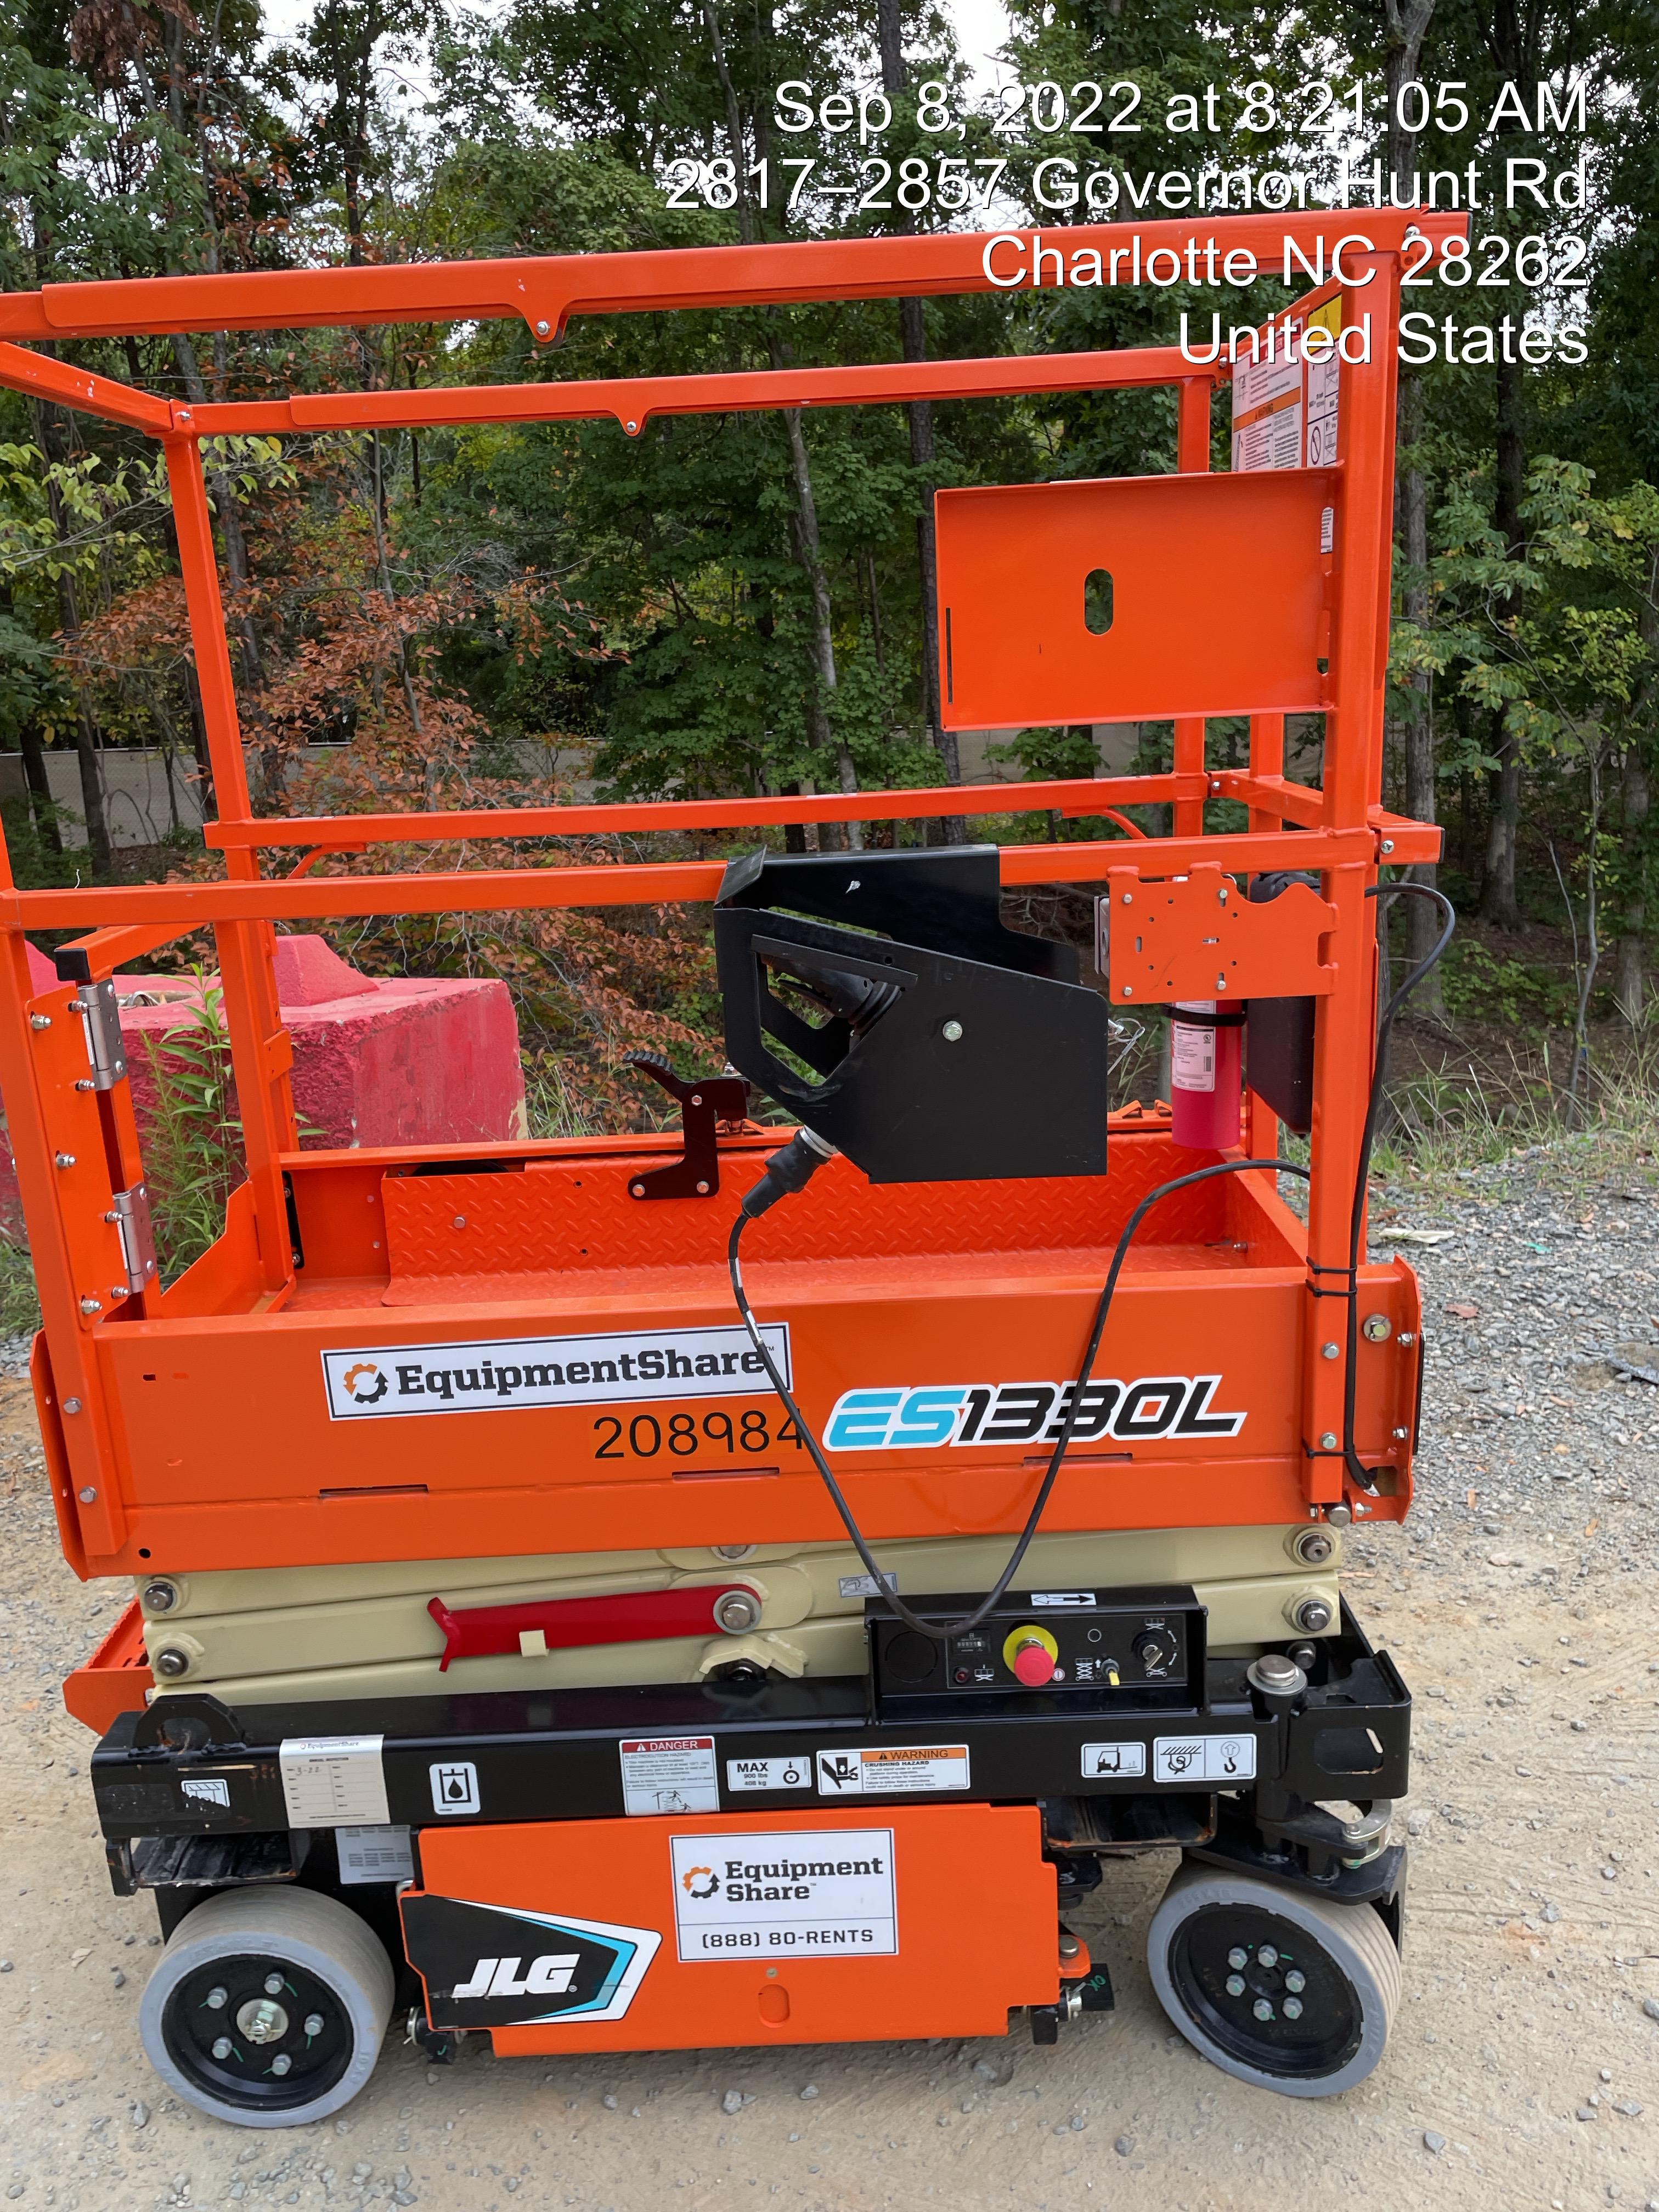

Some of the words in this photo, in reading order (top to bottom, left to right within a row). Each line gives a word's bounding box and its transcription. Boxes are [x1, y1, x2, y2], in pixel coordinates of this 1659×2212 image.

[395, 1348, 766, 1400] EquipmentShare
[827, 1378, 1243, 1448] ES1330L
[593, 1408, 803, 1460] 208984
[650, 1740, 698, 1751] DANGER
[890, 1749, 949, 1760] WARNING
[737, 1762, 769, 1773] MAX
[725, 1858, 883, 1882] Equipment
[726, 1883, 810, 1902] Share
[702, 1932, 760, 1949] (888)
[769, 1929, 874, 1945] 80-RENTS
[450, 1953, 581, 1999] JLG
